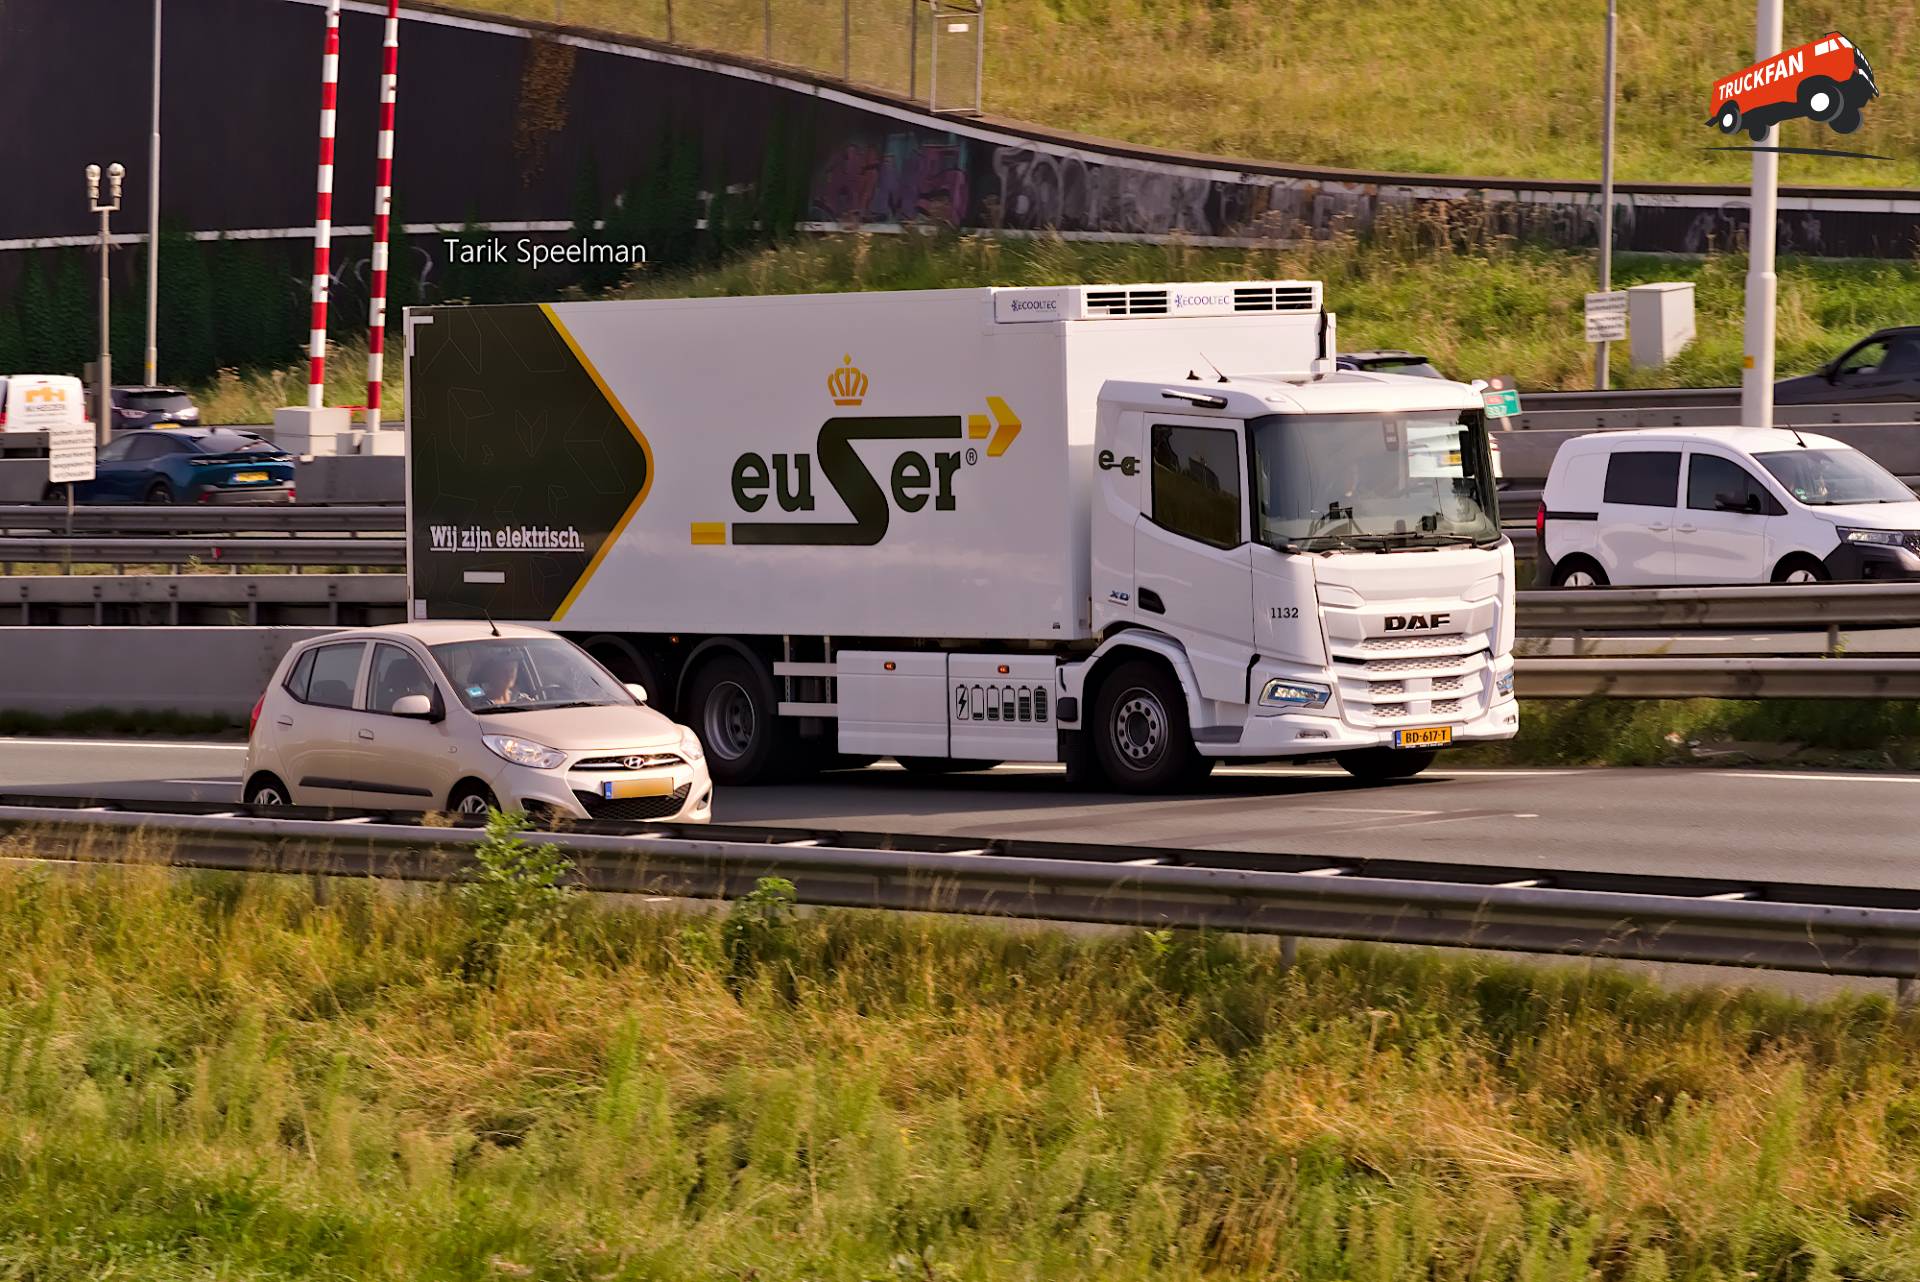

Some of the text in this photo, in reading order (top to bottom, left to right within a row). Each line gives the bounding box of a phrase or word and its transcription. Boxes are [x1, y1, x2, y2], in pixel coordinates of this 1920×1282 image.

[430, 526, 585, 553] Wij zijn elektrisch.
[1271, 607, 1299, 619] 1132
[1384, 613, 1451, 632] DAF
